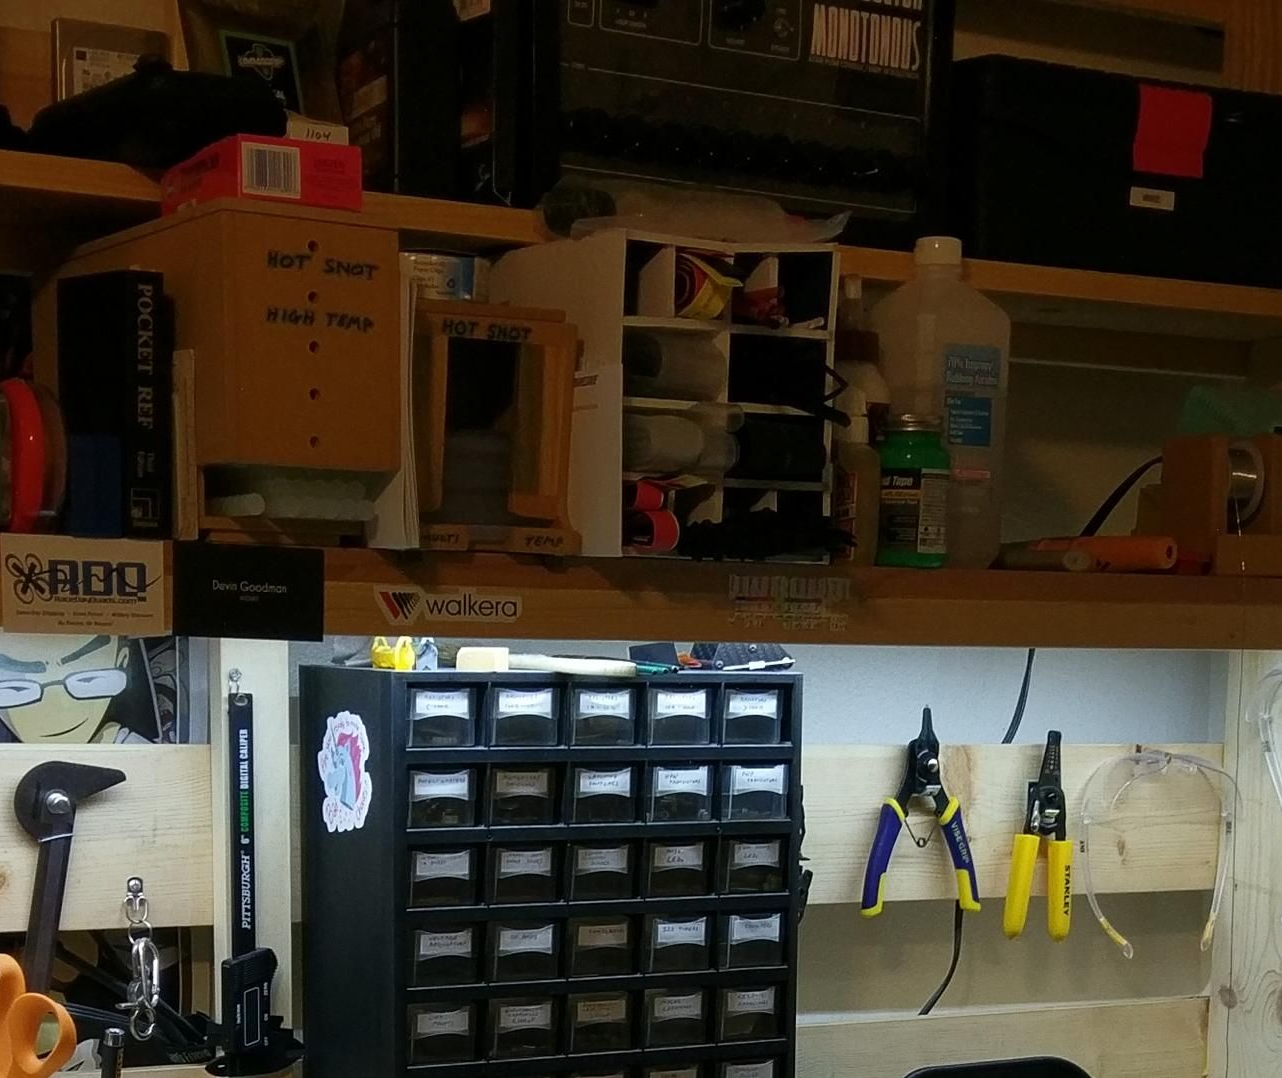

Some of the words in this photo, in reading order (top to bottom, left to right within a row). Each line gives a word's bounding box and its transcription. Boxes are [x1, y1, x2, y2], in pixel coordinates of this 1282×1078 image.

[267, 251, 311, 270] HOT
[323, 259, 380, 281] SNOT
[136, 283, 154, 376] POCKET
[266, 308, 317, 327] HIGH
[325, 312, 375, 334] TEMP
[440, 319, 479, 337] HOT
[487, 323, 534, 341] SNOT
[136, 386, 154, 429] REF
[524, 534, 565, 548] TEMP
[212, 578, 238, 592] Devin
[239, 580, 288, 594] Goodman
[425, 596, 518, 618] walkera
[239, 728, 249, 756] CALIPER
[239, 757, 249, 789] DIGITAL
[240, 791, 249, 832] COMPOSITE
[240, 852, 251, 930] PITTSBURGH
[1063, 864, 1071, 916] STANLEY
